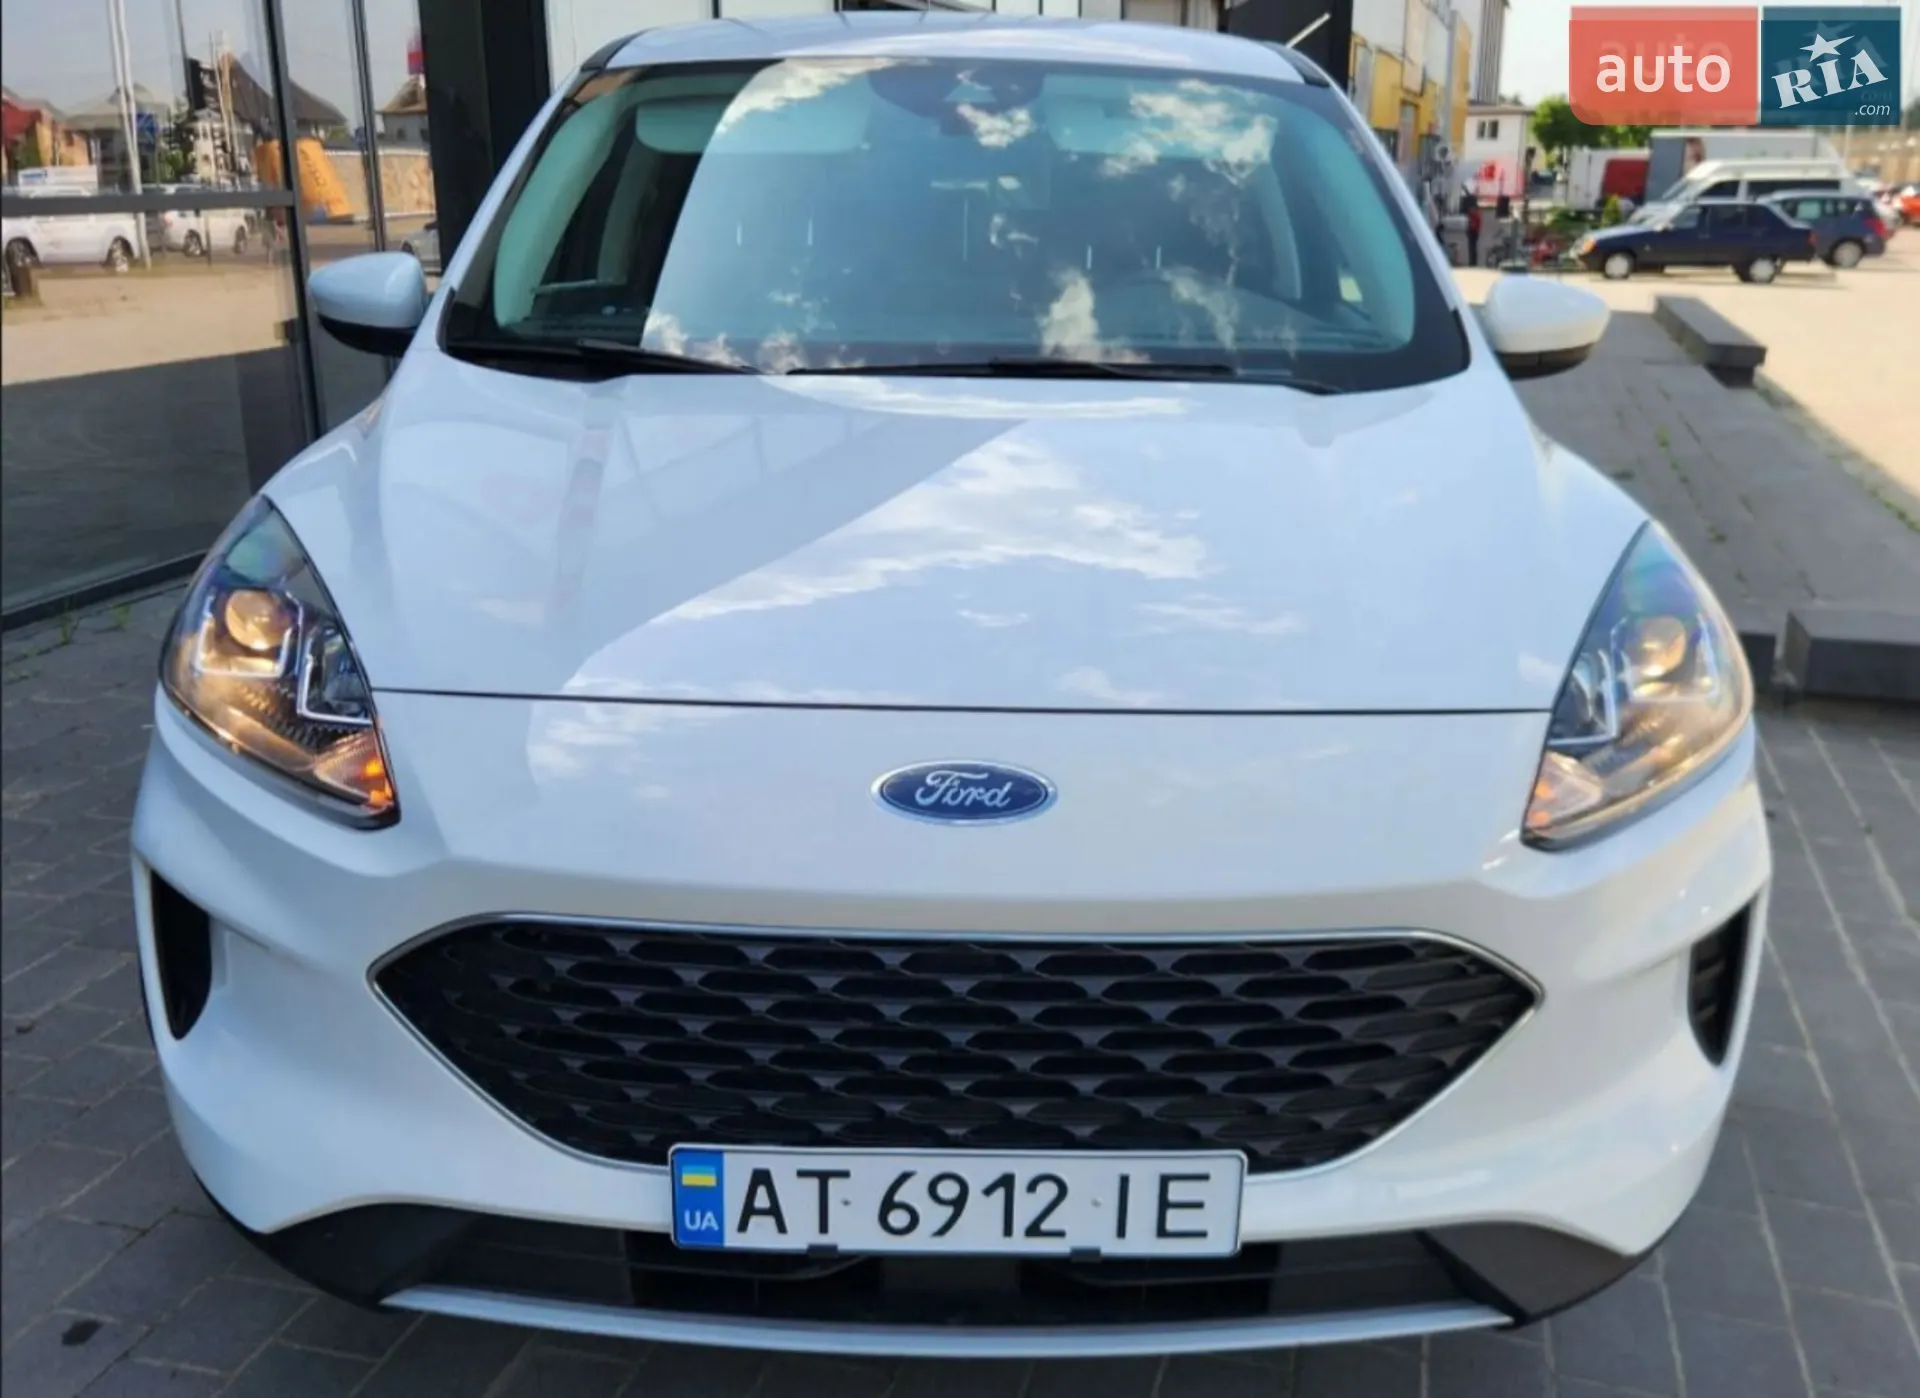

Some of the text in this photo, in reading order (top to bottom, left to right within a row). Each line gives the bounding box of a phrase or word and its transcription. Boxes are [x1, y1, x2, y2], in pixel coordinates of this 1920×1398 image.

[915, 770, 1013, 808] Ford
[684, 1210, 720, 1231] UA
[736, 1168, 1211, 1240] AT 6912 IE
